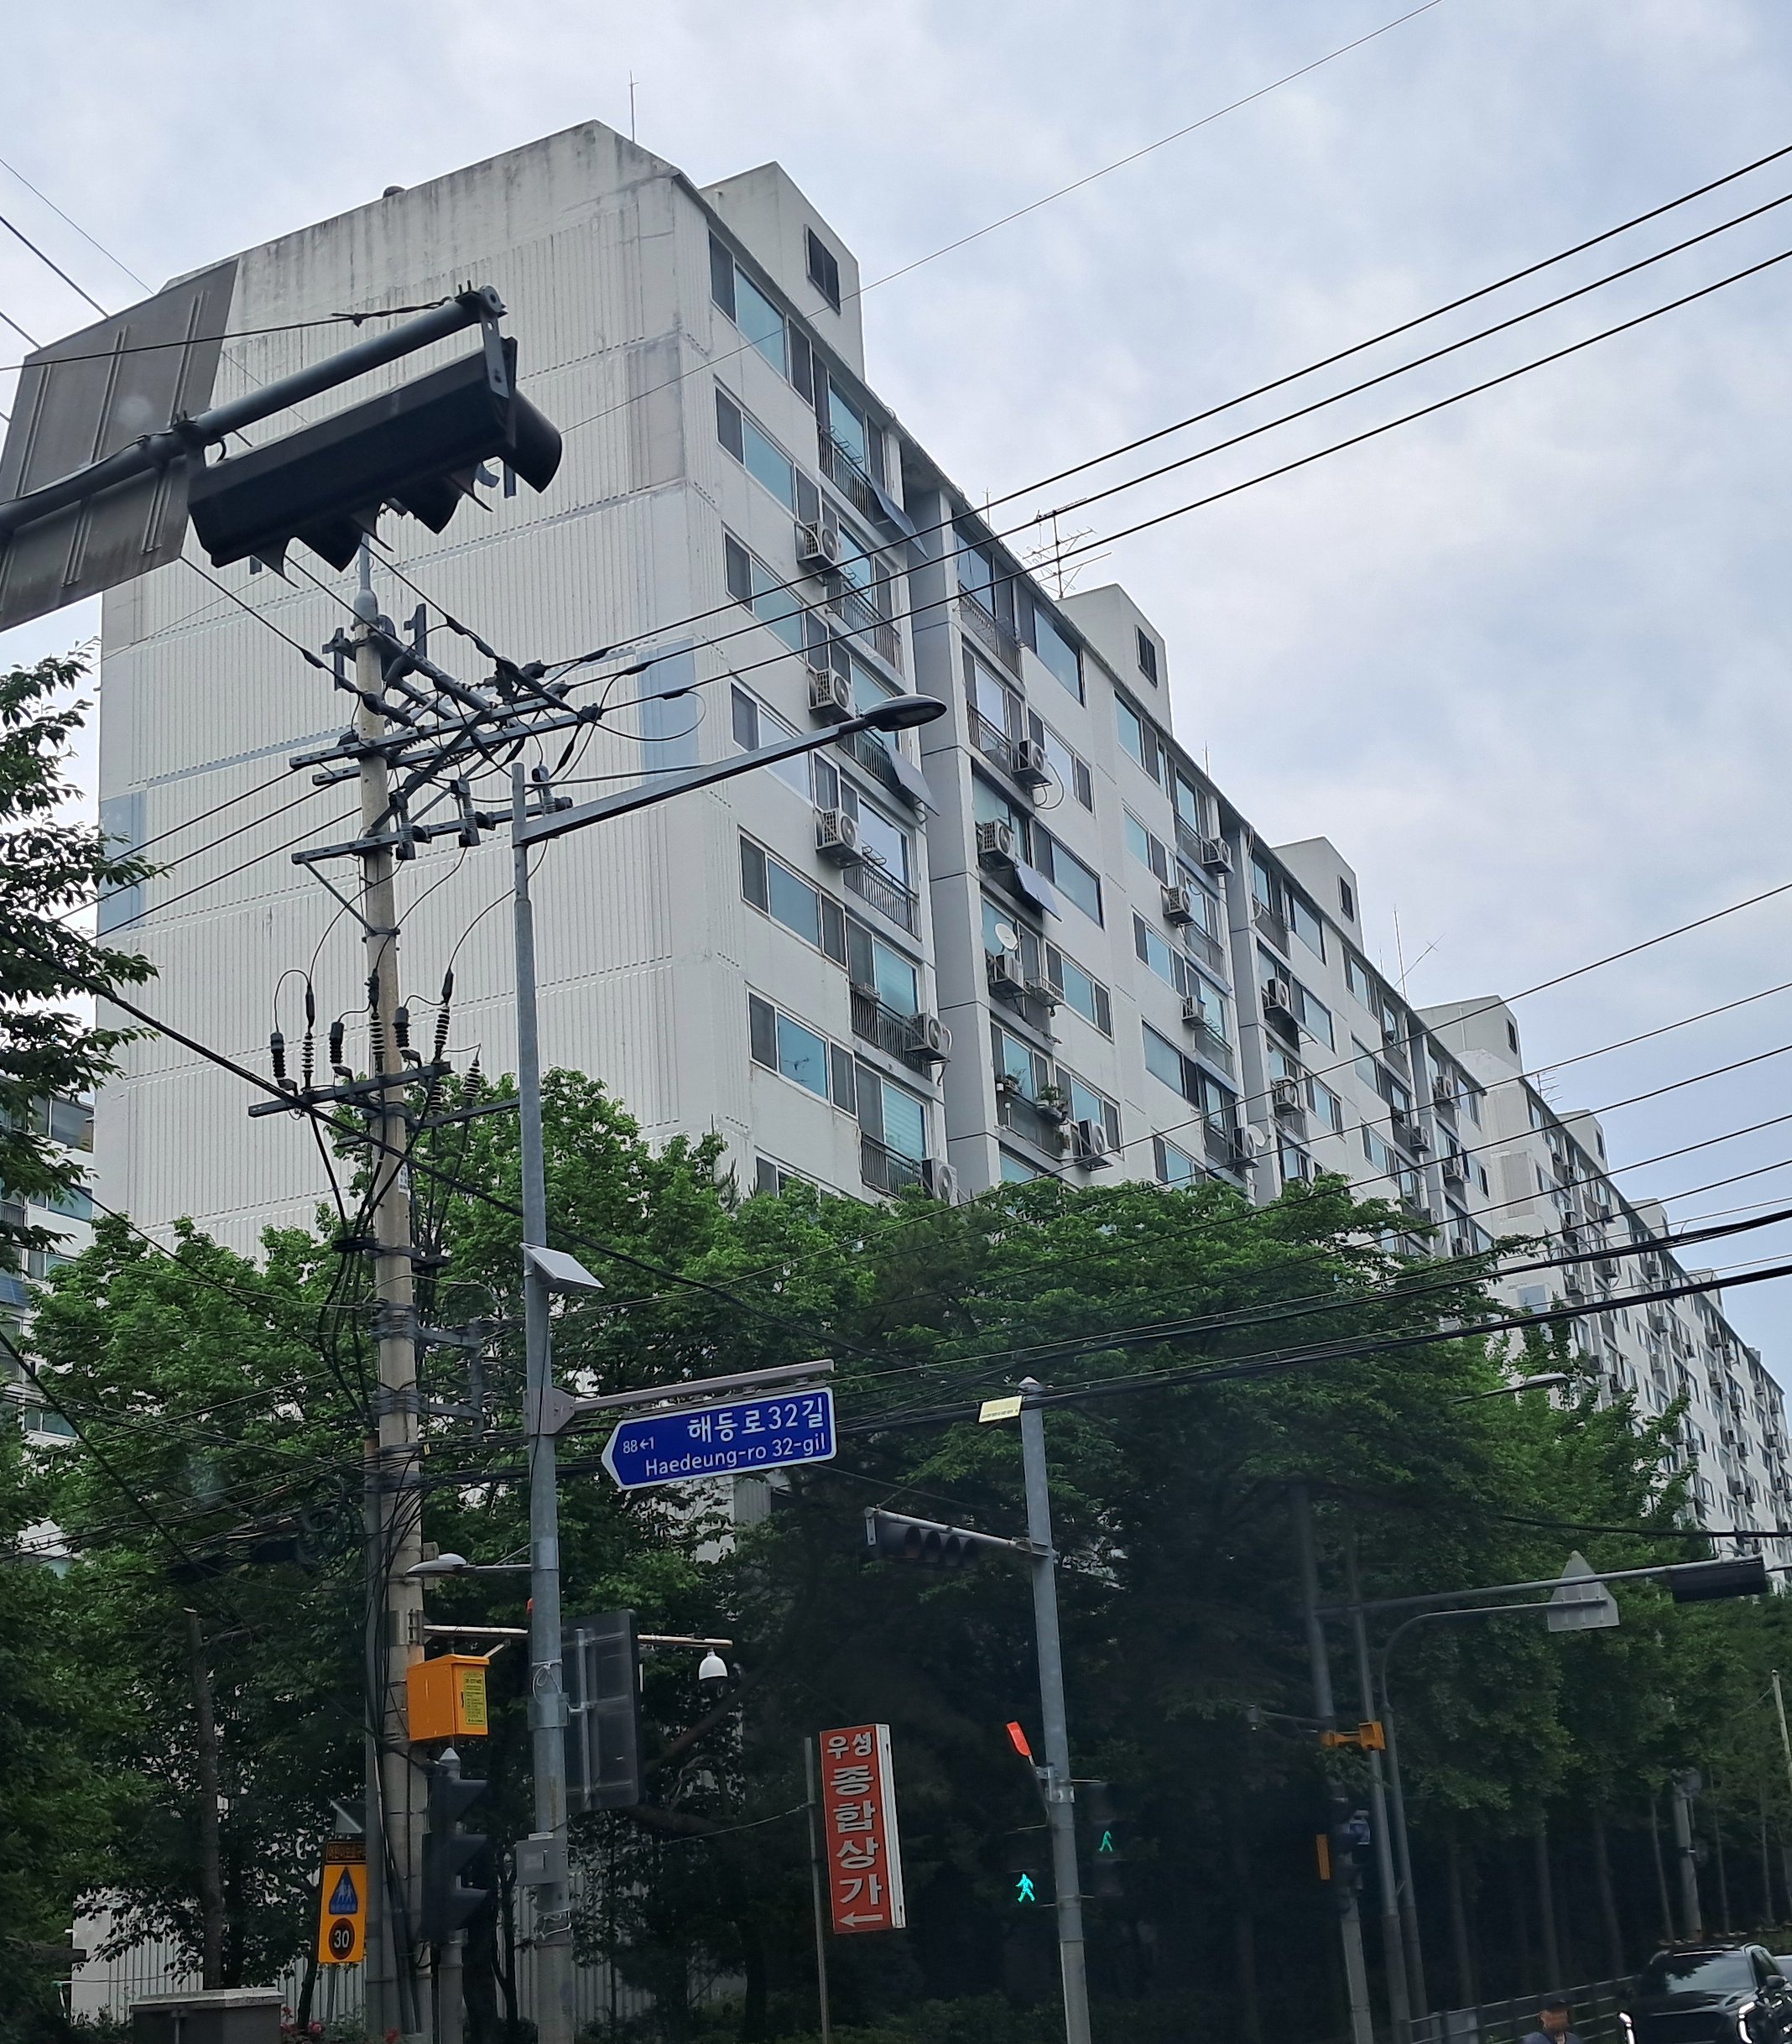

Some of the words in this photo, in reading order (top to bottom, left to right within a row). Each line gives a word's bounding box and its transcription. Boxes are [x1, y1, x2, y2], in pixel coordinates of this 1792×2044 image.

[686, 1396, 824, 1443] 해등로32길
[645, 1445, 767, 1477] Haedeung-ro
[772, 1432, 826, 1457] 32-gil
[826, 1731, 873, 1760] 우성
[830, 1765, 883, 1906] 종합상가
[333, 1929, 351, 1949] 30
